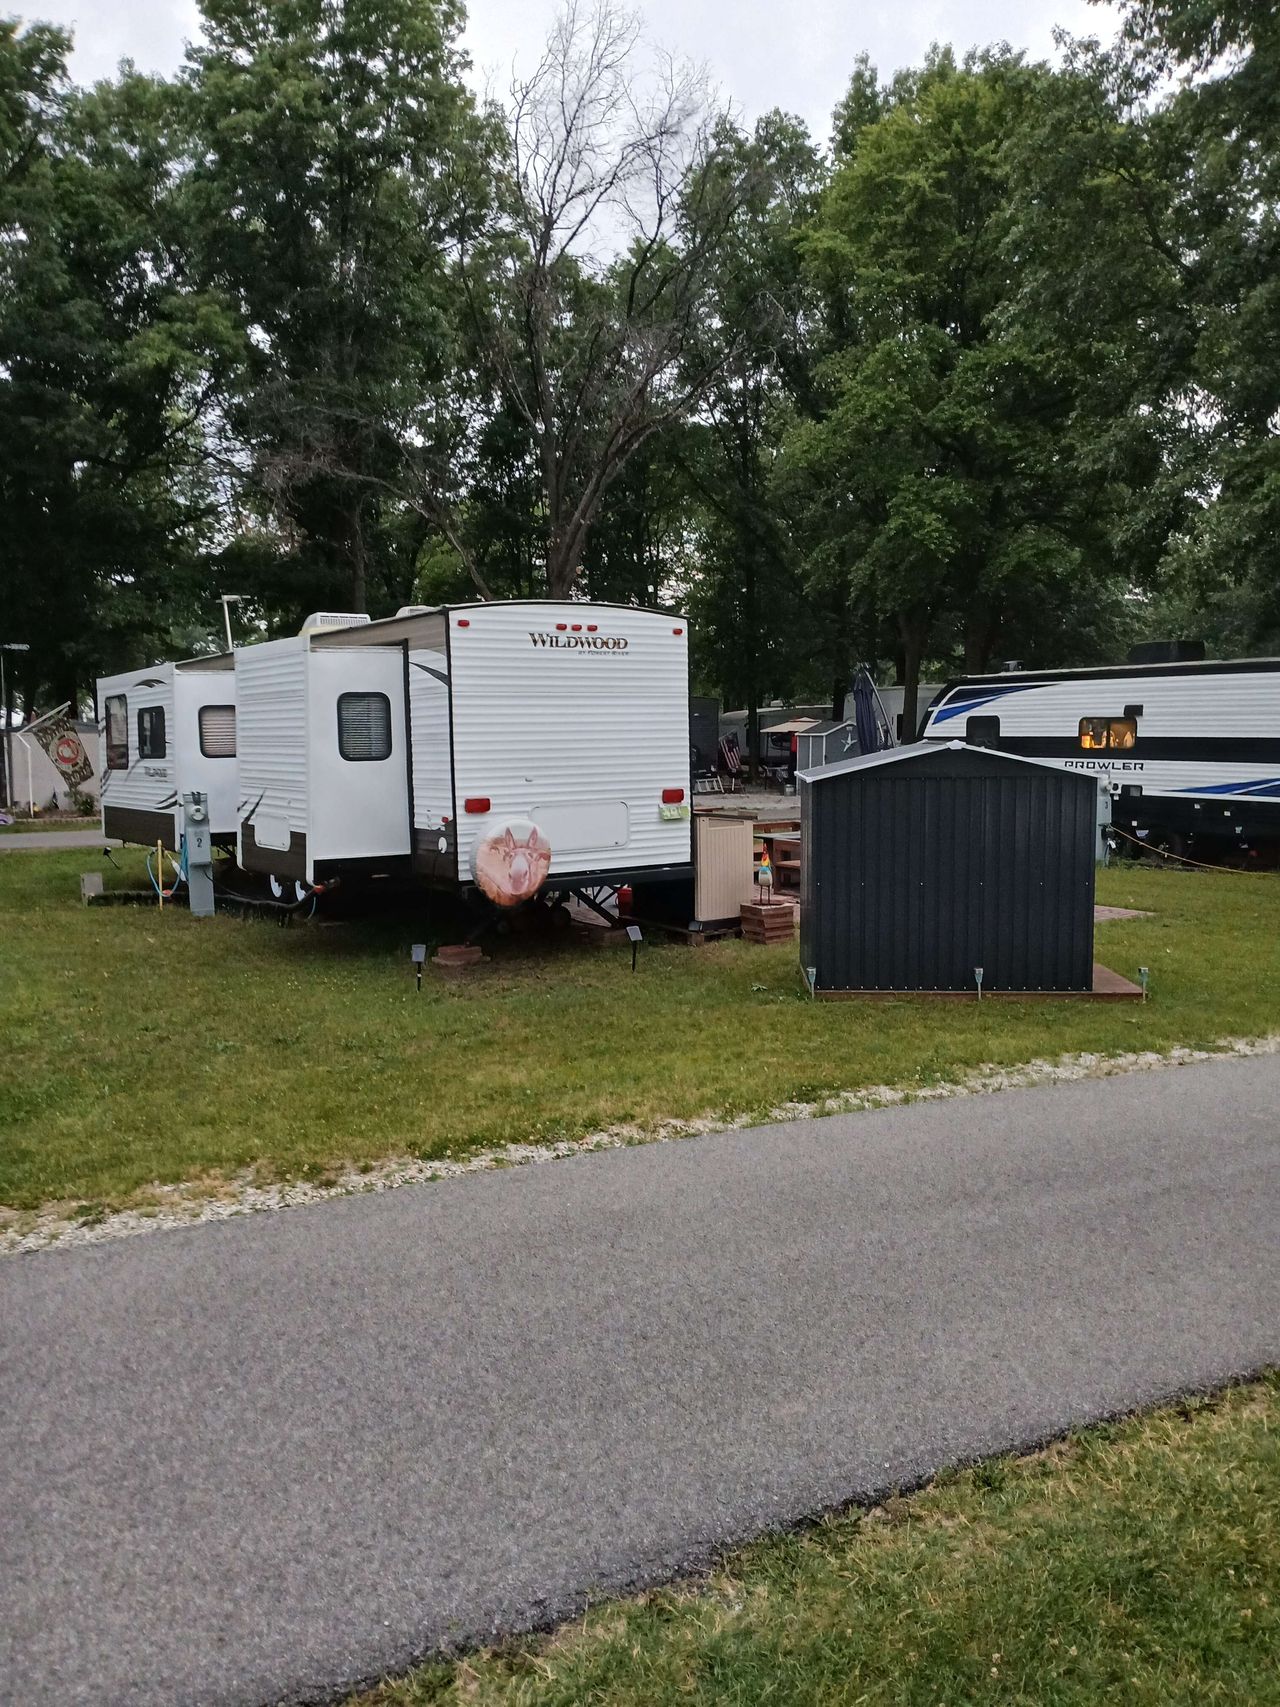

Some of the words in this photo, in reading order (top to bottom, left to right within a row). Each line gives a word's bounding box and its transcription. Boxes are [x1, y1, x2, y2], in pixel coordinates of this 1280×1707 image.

[528, 632, 629, 650] WILDWOOD
[1064, 760, 1144, 771] PROWLER
[196, 837, 203, 848] 2
